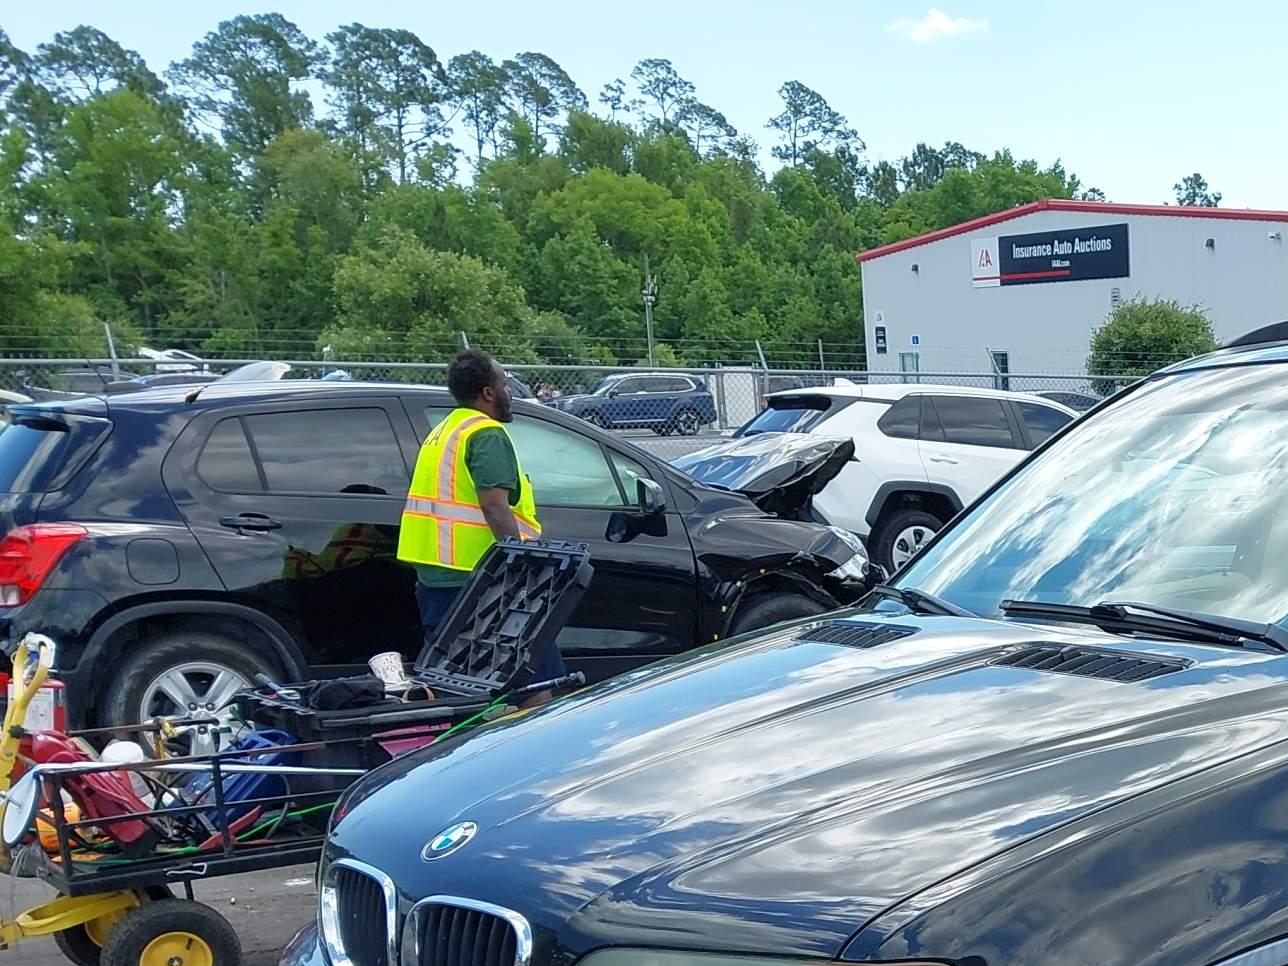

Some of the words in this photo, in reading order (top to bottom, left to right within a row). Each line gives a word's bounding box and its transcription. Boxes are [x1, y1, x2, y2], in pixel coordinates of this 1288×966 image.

[1012, 243, 1052, 259] Insurance
[1053, 239, 1072, 255] Auto
[1073, 236, 1112, 253] Auctions
